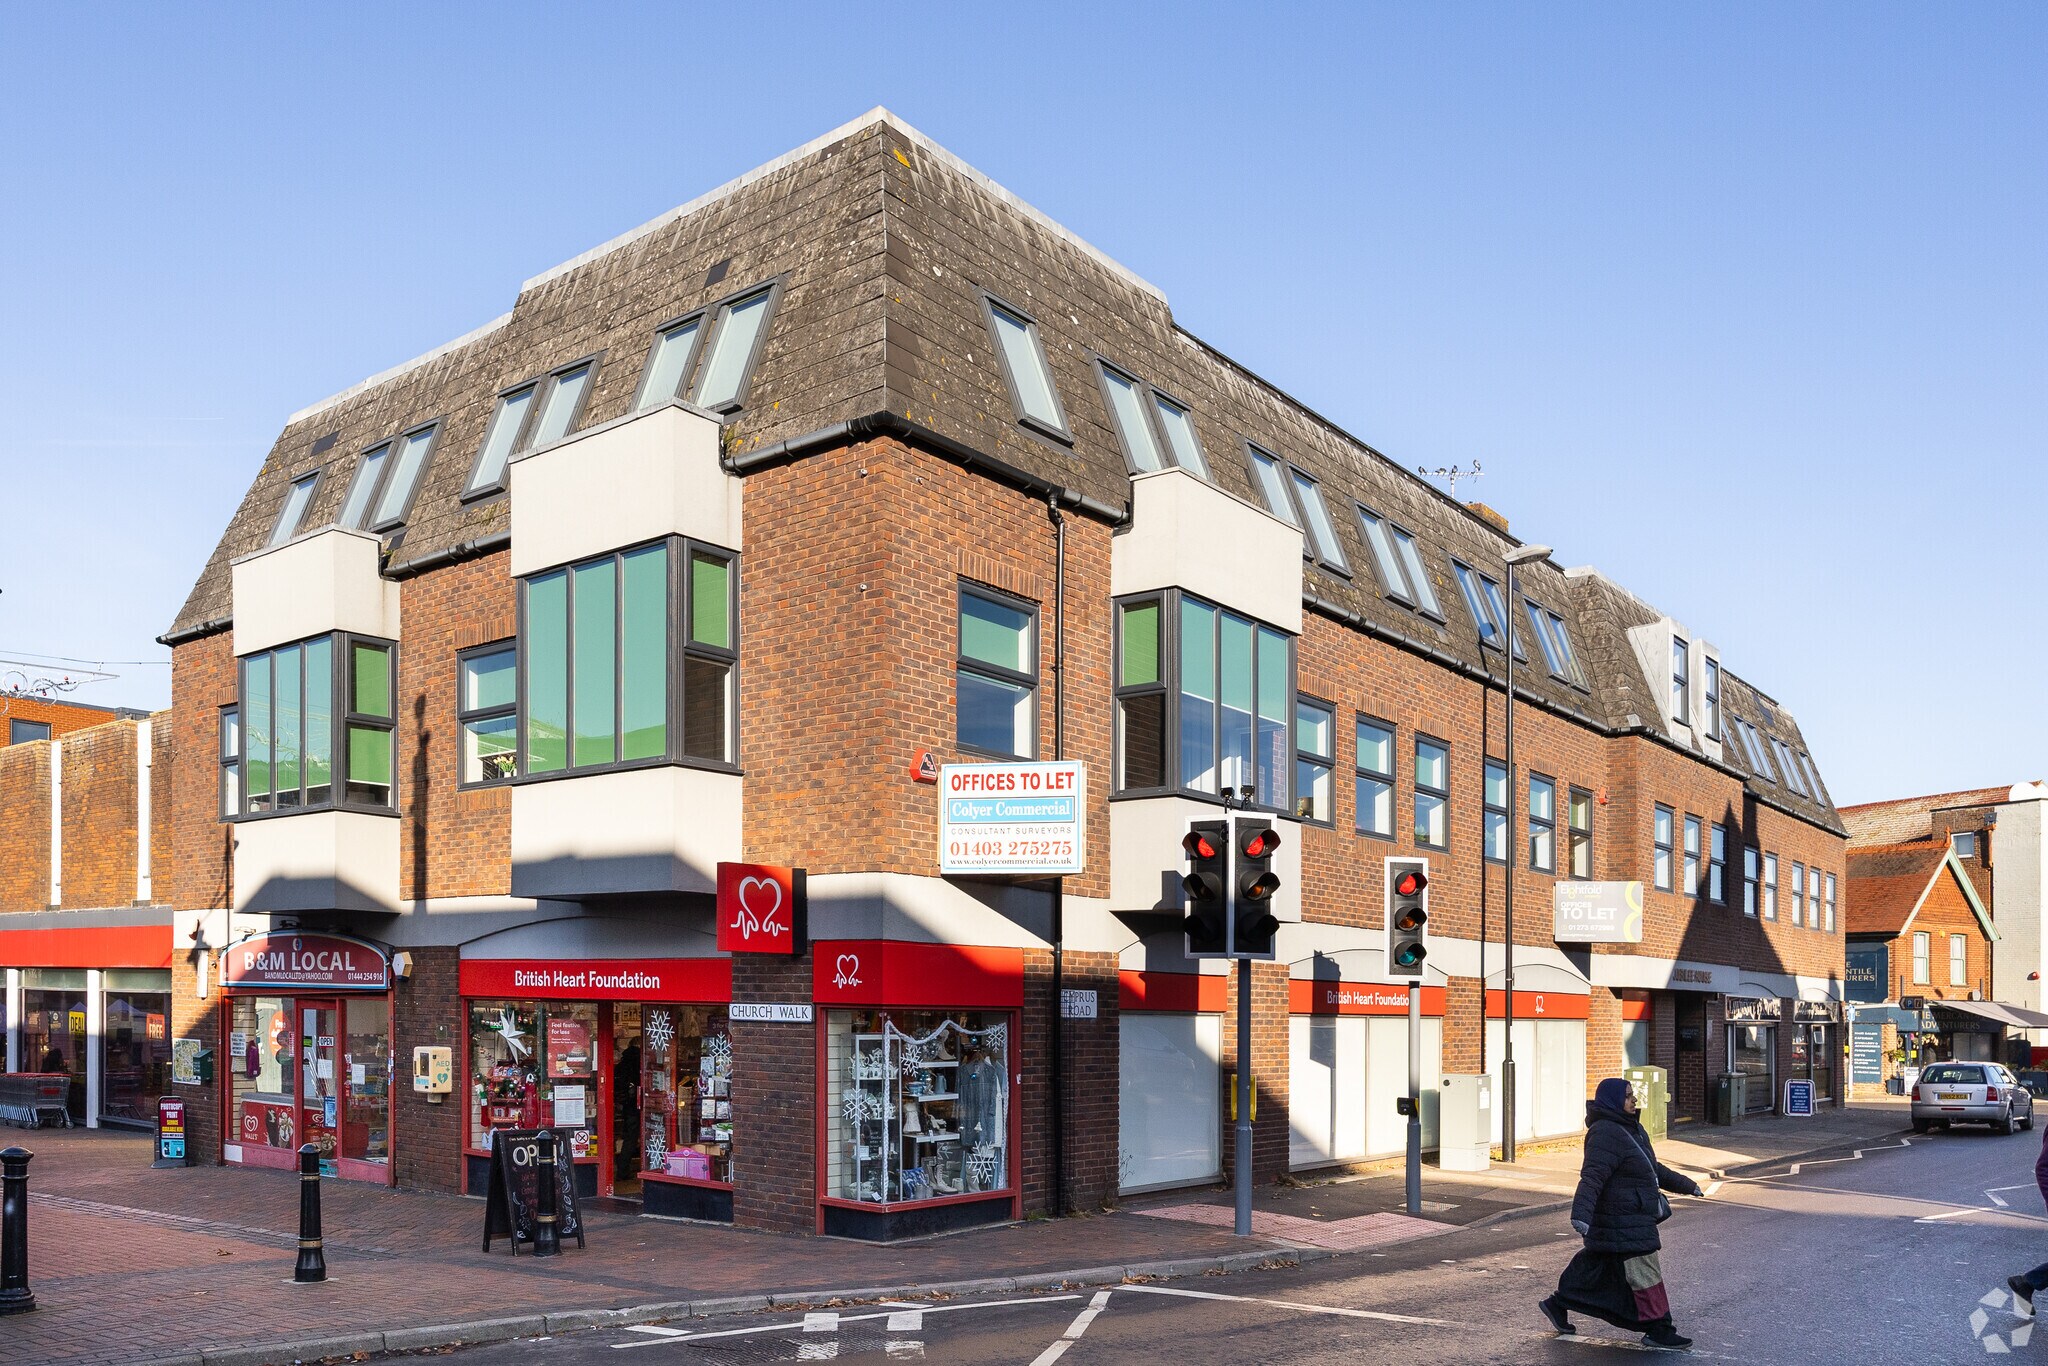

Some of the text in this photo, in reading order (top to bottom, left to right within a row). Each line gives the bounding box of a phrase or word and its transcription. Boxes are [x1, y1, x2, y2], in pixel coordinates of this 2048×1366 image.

[952, 772, 1074, 790] OFFICES TO LET
[952, 800, 1070, 819] Colyer Commercial
[951, 841, 1072, 856] 01403 275275
[950, 857, 1072, 866] www.colyercommercial.co.uk
[1561, 884, 1602, 899] Eightfold
[1560, 908, 1617, 920] TO LET
[244, 952, 355, 971] B&M LOCAL
[265, 972, 332, 980] BANDMLOCALLTD@YAHOO.COM
[515, 970, 660, 988] British Heart Foundation
[1064, 991, 1095, 1002] CYPRUS
[1327, 990, 1409, 1006] British Heart Foundatio
[732, 1006, 808, 1018] CHURCH WALK
[1069, 1005, 1091, 1016] ROAD
[1912, 1010, 1931, 1019] TE
[149, 1024, 162, 1039] FREE
[321, 1037, 332, 1045] OPEN
[513, 1144, 557, 1166] OP
